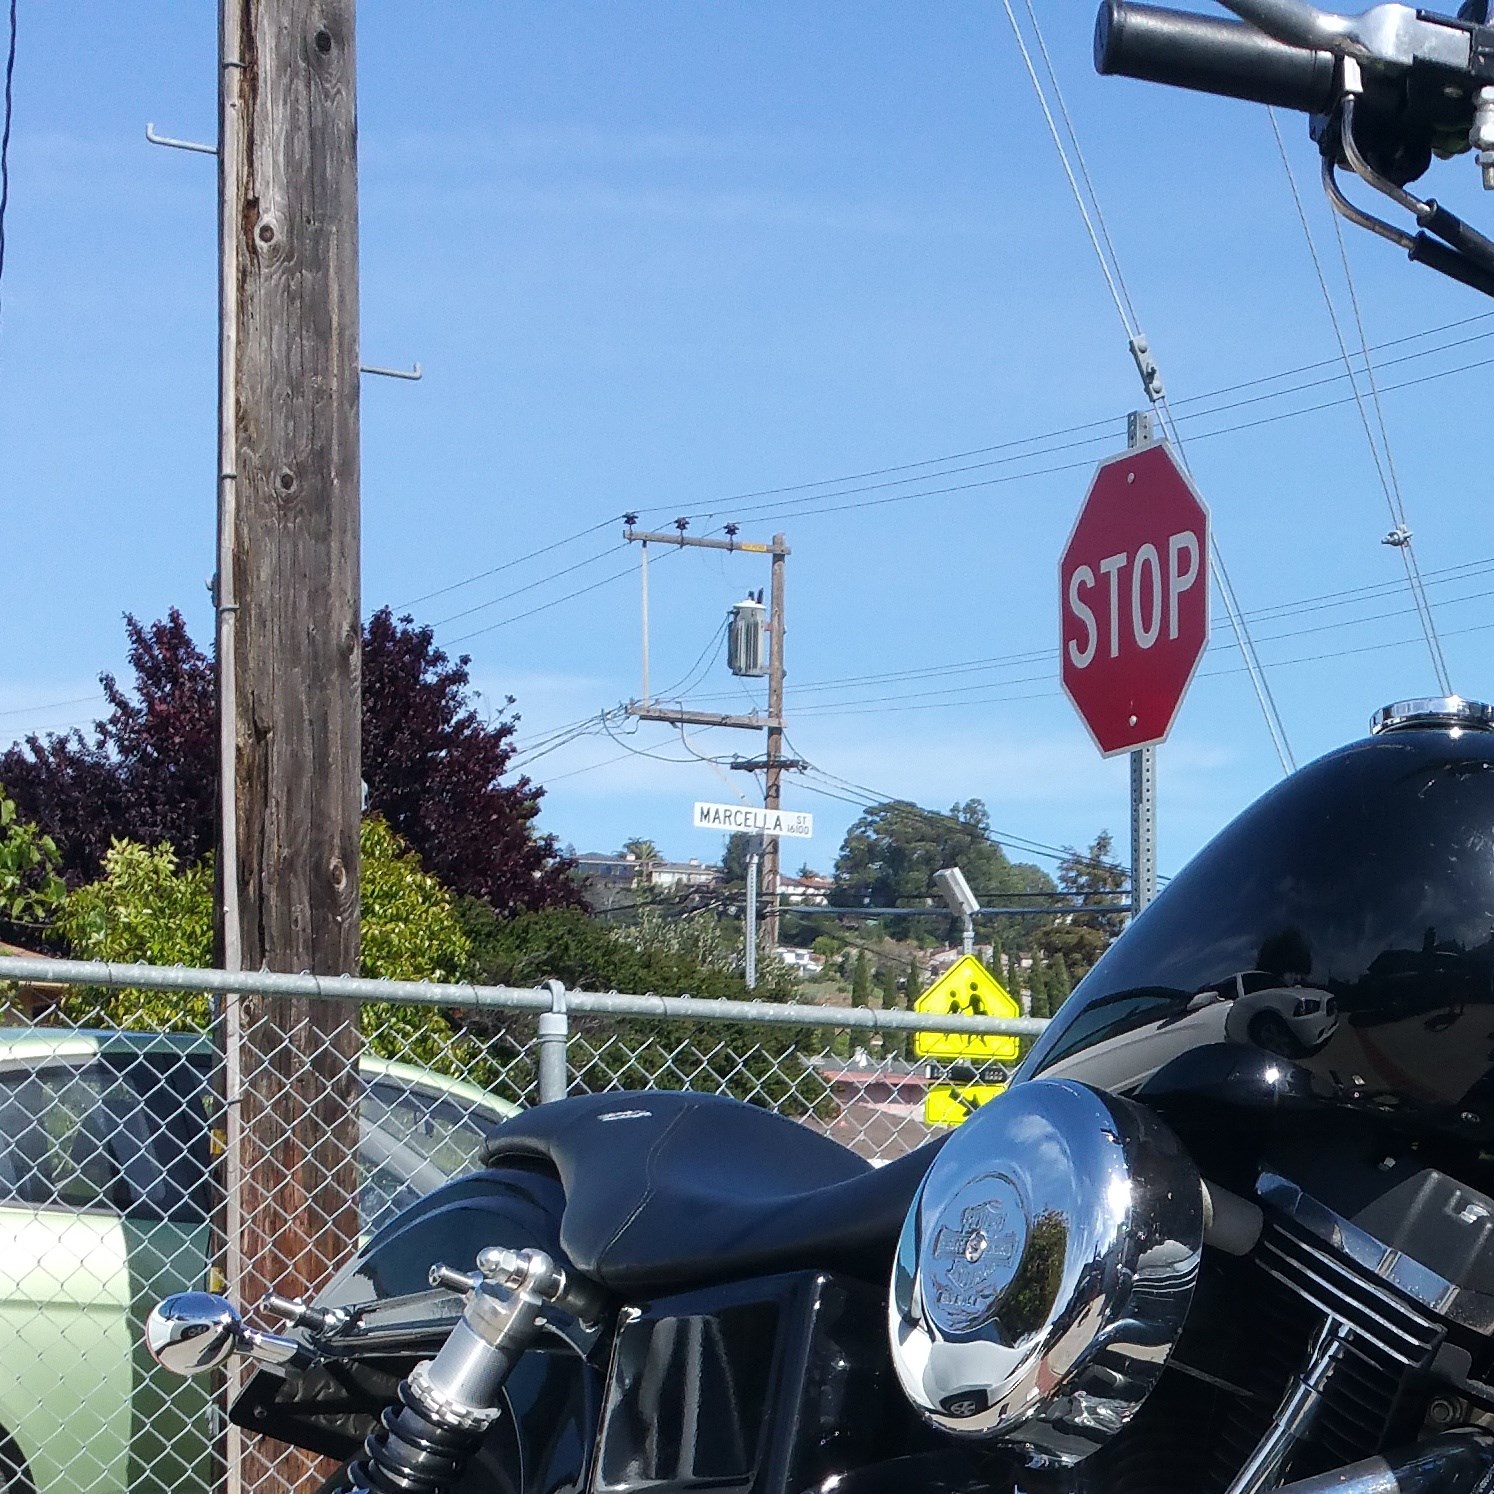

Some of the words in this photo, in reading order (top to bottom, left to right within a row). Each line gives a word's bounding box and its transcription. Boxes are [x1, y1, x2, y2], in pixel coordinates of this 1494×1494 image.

[1068, 530, 1200, 669] STOP
[699, 806, 783, 832] MARCELLA
[796, 815, 807, 825] ST
